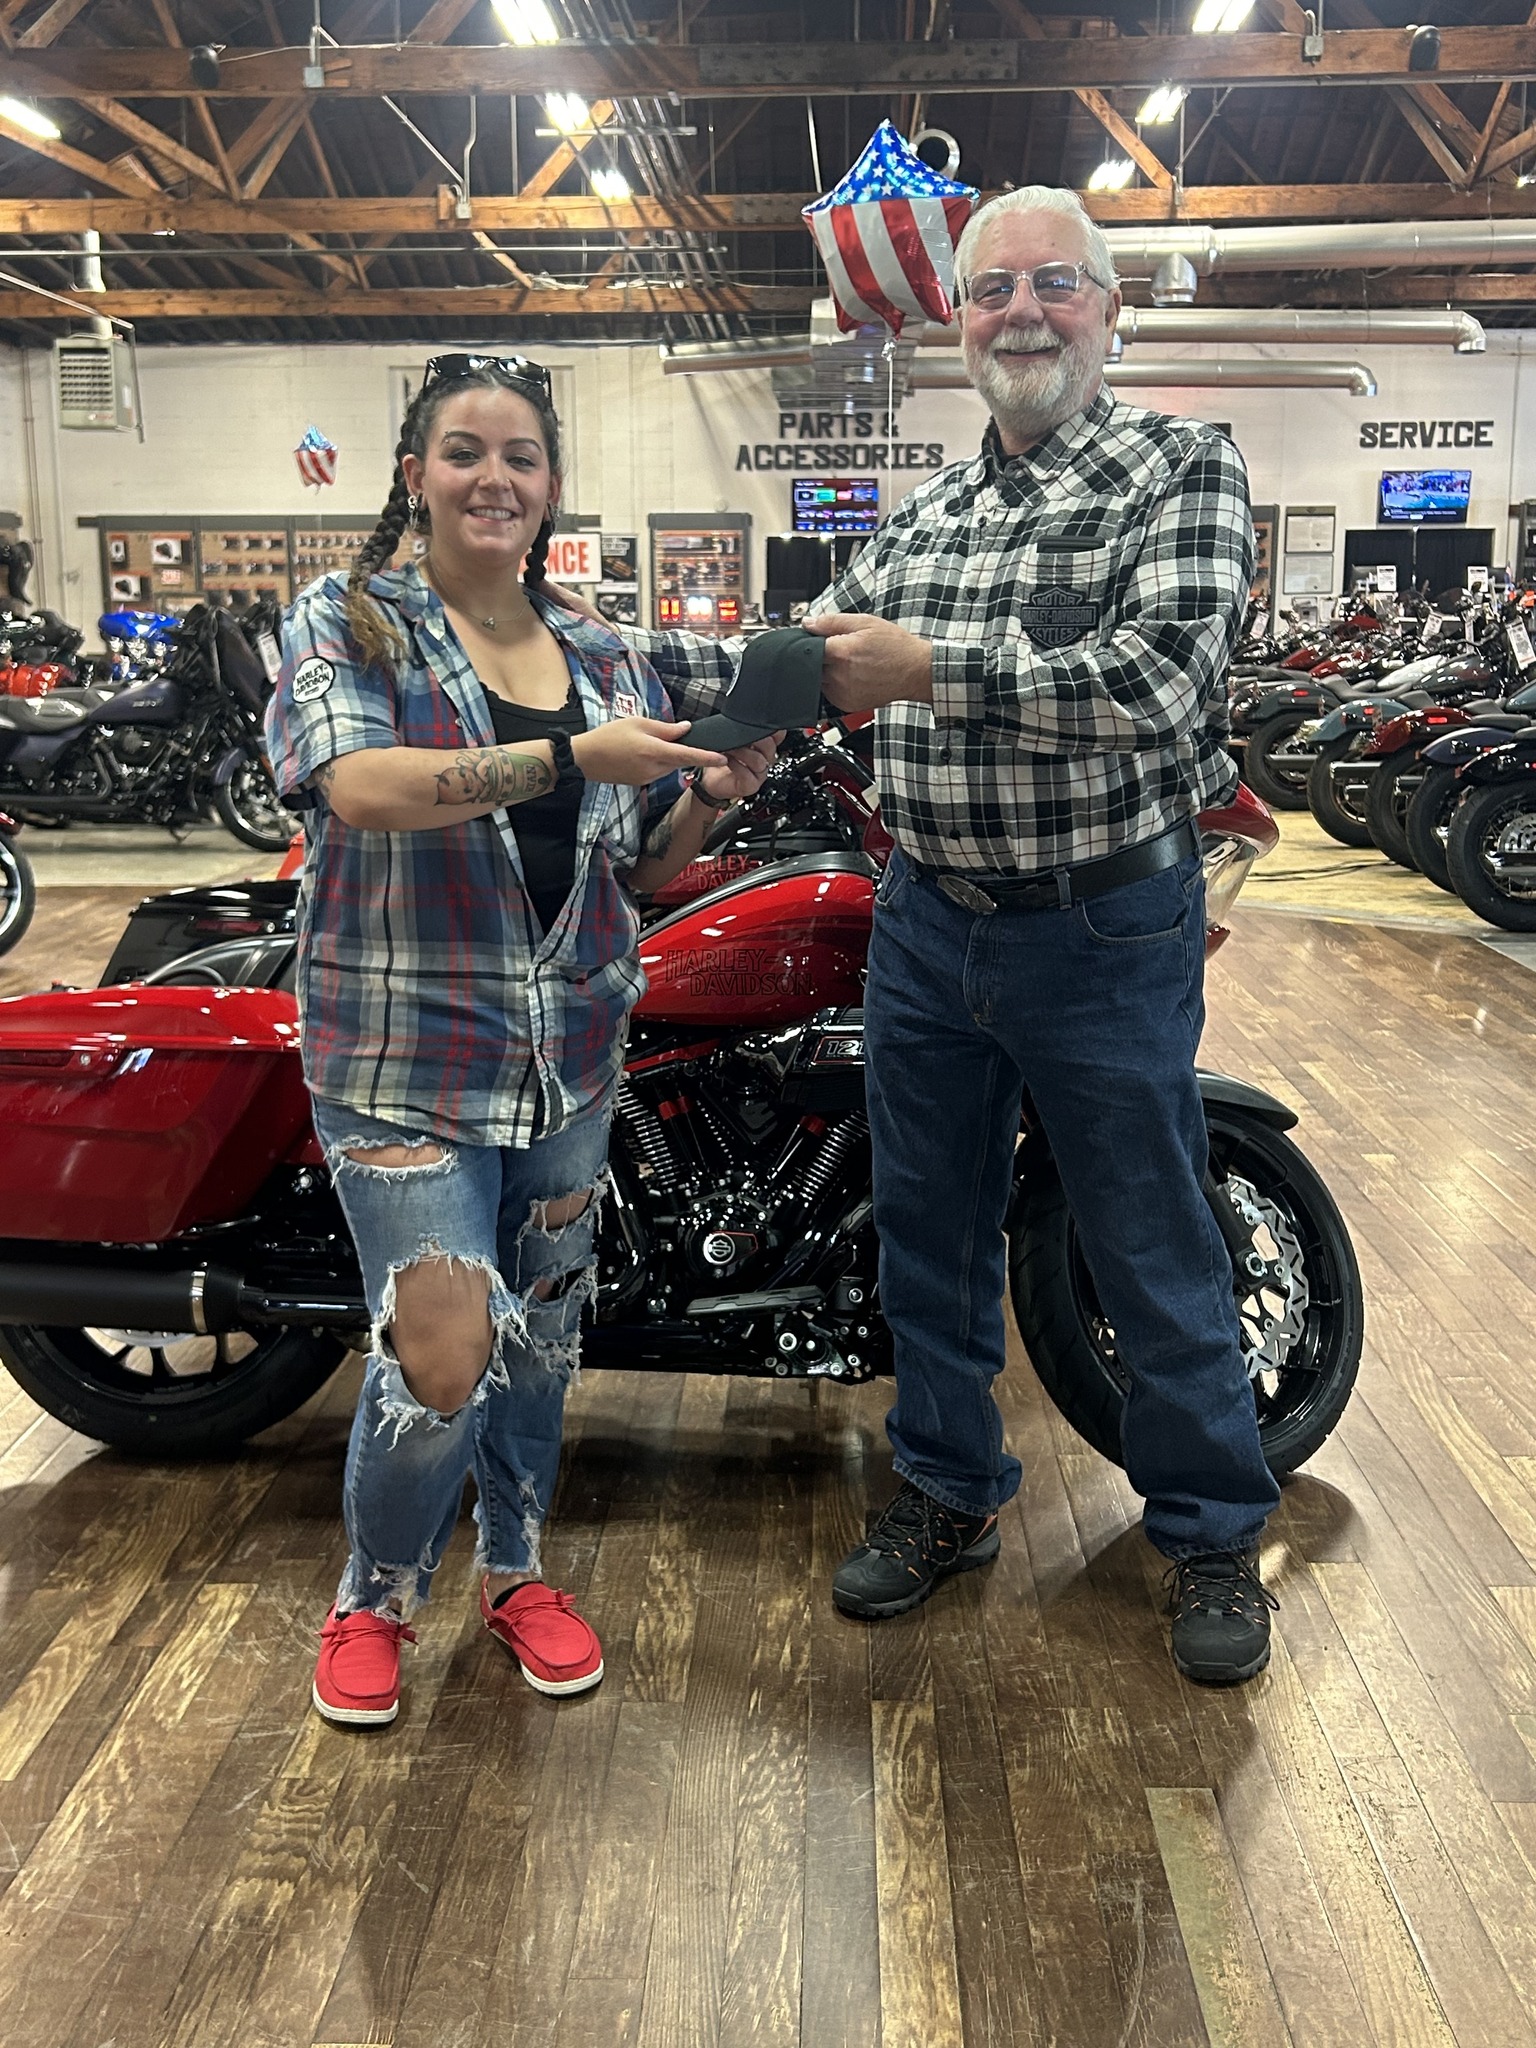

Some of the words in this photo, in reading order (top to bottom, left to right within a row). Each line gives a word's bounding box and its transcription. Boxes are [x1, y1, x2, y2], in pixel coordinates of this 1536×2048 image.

[779, 412, 873, 438] PARTS
[881, 412, 899, 438] &
[1360, 421, 1494, 448] SERVICE
[735, 443, 944, 471] ACCESSORIES
[1037, 591, 1076, 606] MOTOR
[1023, 609, 1093, 624] HARLEY-DAVIDSON
[1035, 627, 1075, 645] CYCLES
[295, 672, 330, 697] DAVIDSON
[297, 663, 328, 686] HARLEY-
[665, 949, 780, 983] HARLEY-
[690, 973, 812, 996] DAVIDSON
